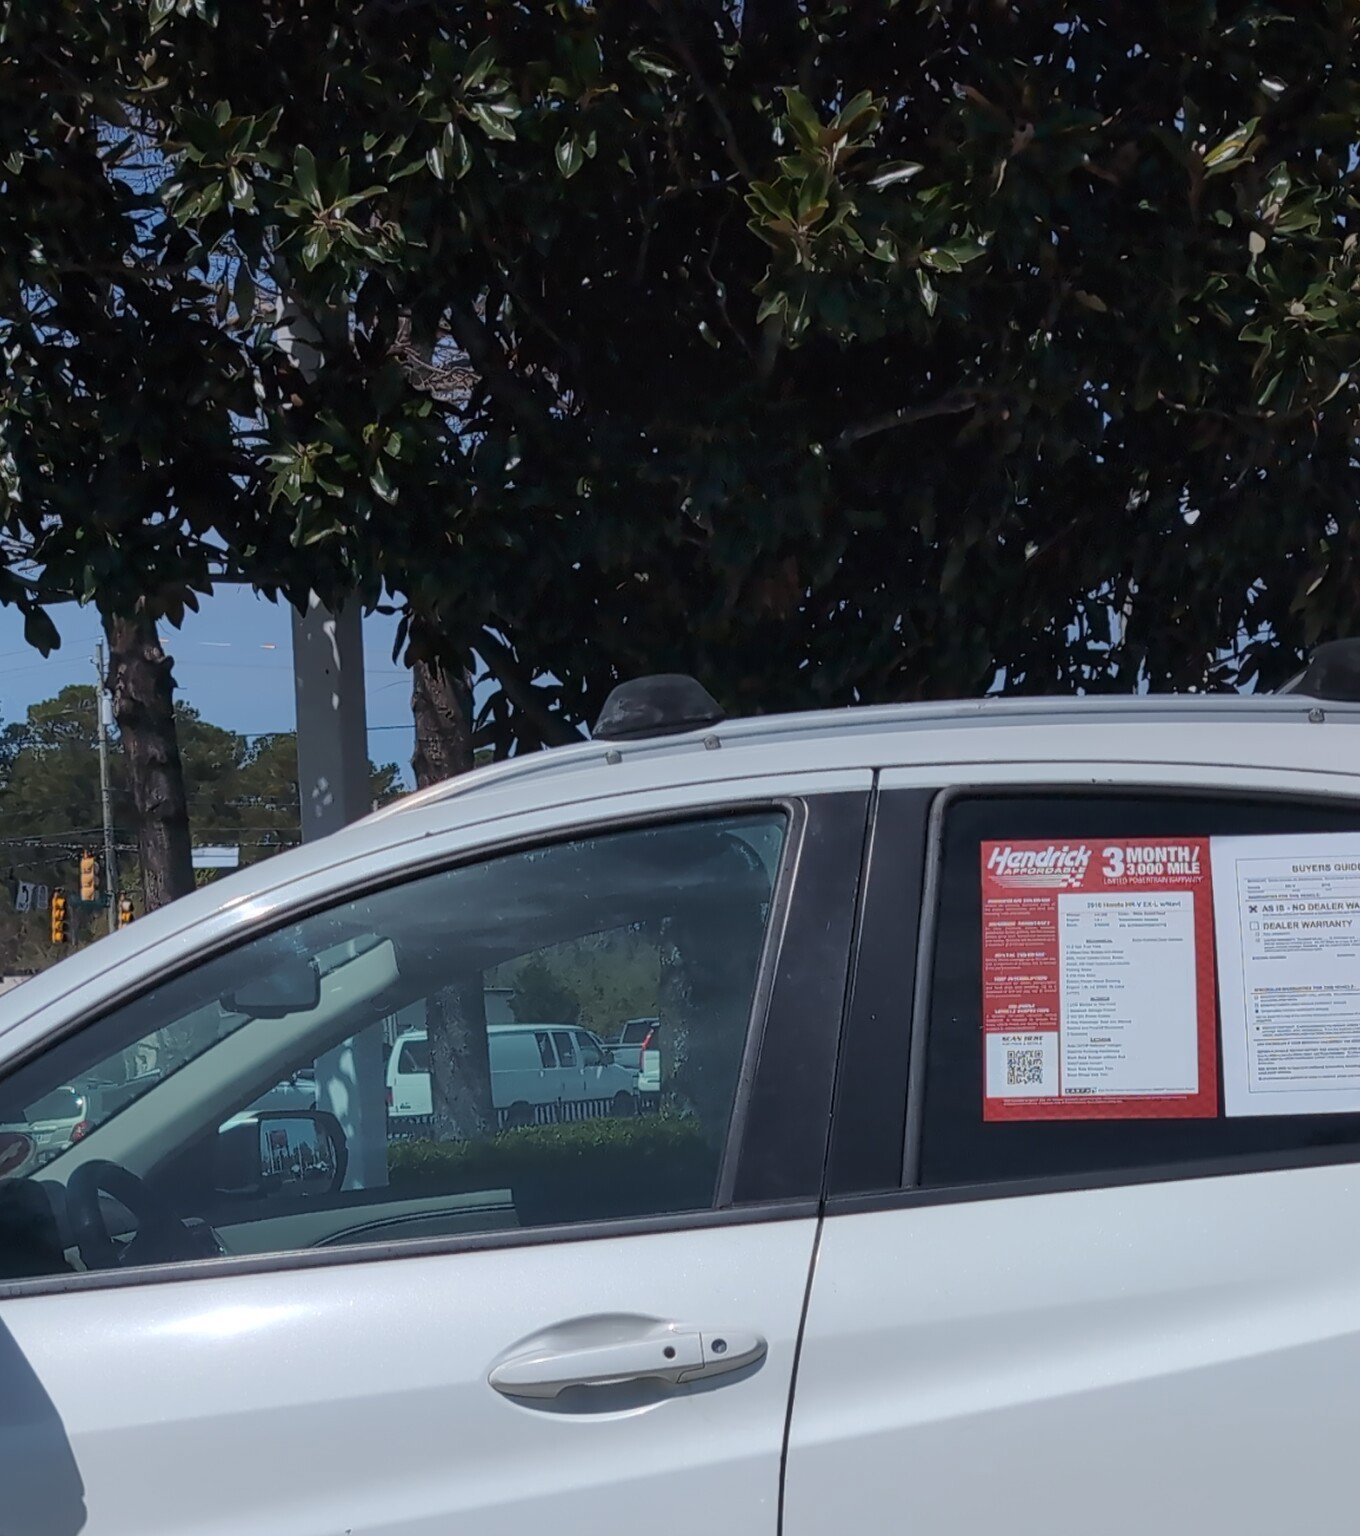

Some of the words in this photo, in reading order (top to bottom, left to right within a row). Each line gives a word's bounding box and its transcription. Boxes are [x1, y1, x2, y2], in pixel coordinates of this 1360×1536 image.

[986, 846, 1093, 876] Hendrick
[1102, 846, 1125, 878] 3
[1126, 846, 1200, 863] MONTH/
[1003, 867, 1086, 875] AFFORDABLE
[1126, 863, 1165, 876] 3,000
[1167, 862, 1200, 875] MILE
[1291, 864, 1332, 873] BUYERS
[1262, 905, 1274, 913] AS
[1275, 904, 1285, 912] IS
[1306, 902, 1344, 911] DEALER
[1263, 921, 1300, 930] DEALER
[1301, 920, 1353, 929] WARRANTY
